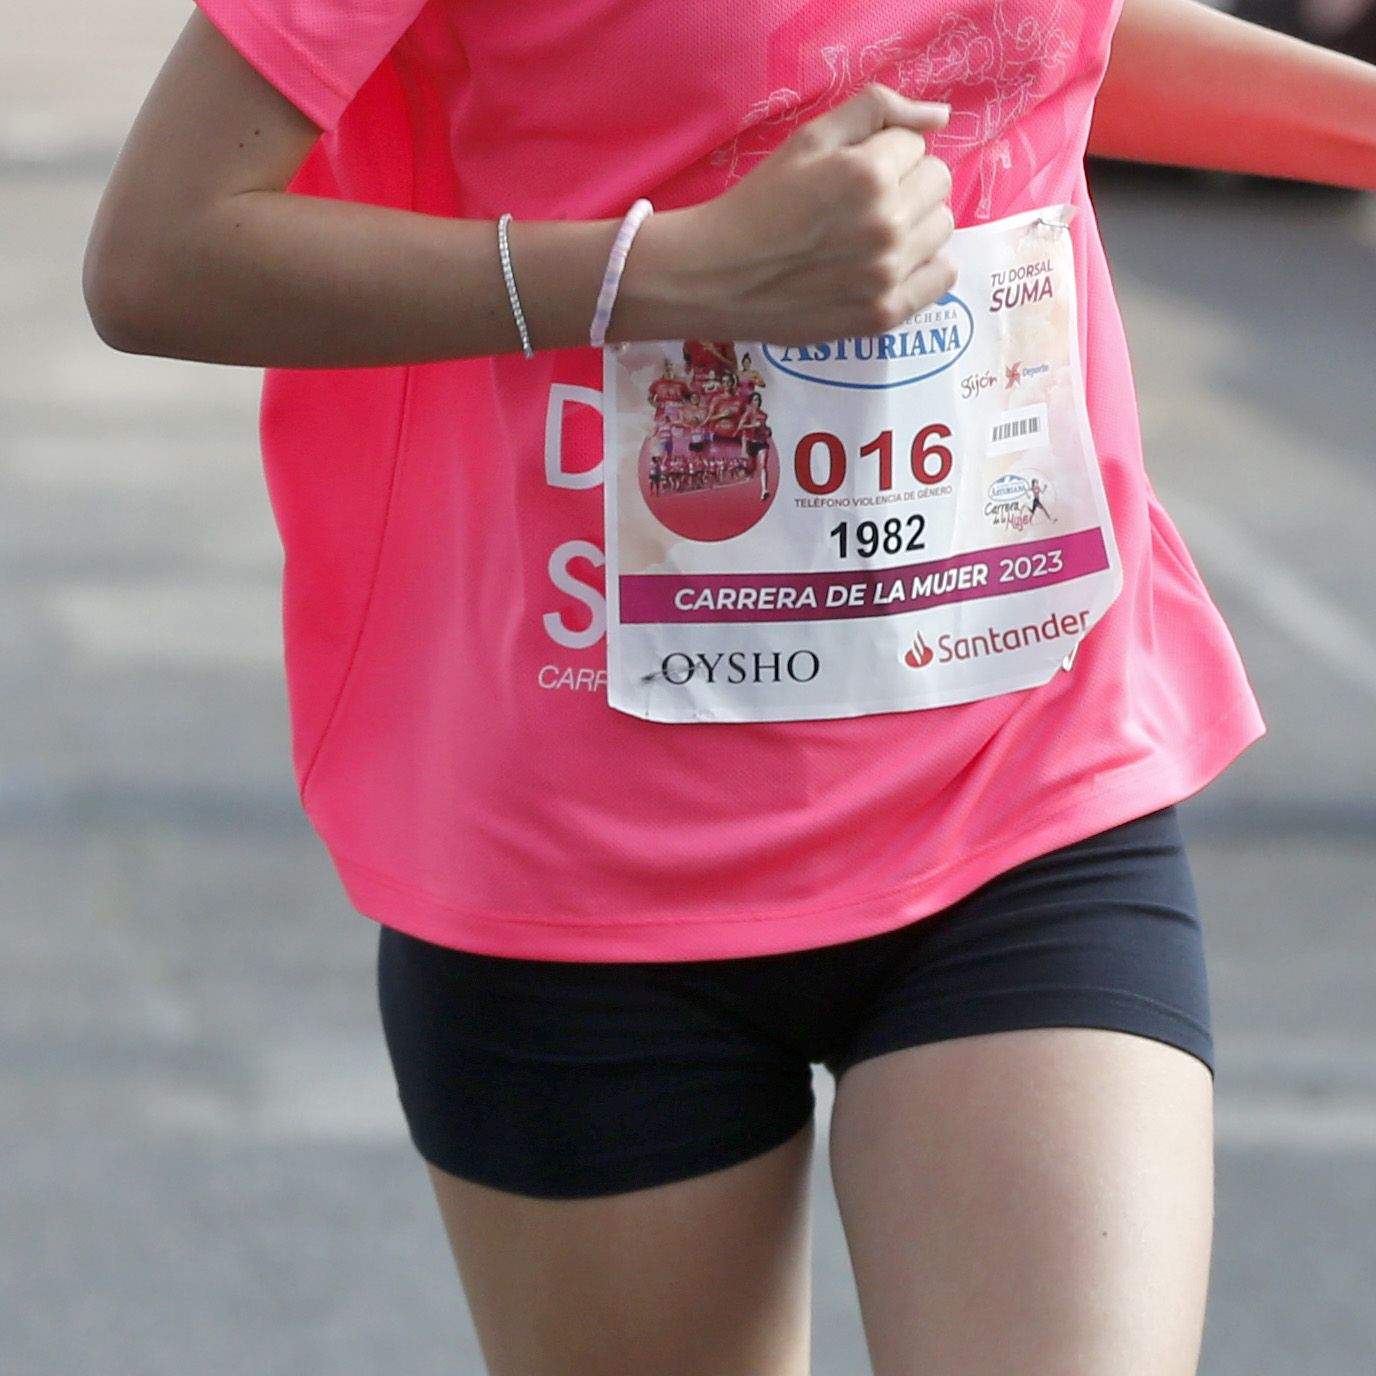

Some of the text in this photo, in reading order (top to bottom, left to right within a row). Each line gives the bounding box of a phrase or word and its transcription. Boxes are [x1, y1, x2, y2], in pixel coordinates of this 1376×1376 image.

[989, 277, 1054, 313] SUMA
[990, 259, 1054, 287] TU DORSAL
[794, 423, 953, 495] 016
[795, 485, 953, 509] TELÉFONO VIOLENCIA DE GÉNERO
[830, 514, 926, 559] 1982
[675, 550, 1063, 611] CARRERA DE LA MUJER 2023
[661, 610, 1090, 685] OYSHO Santander
